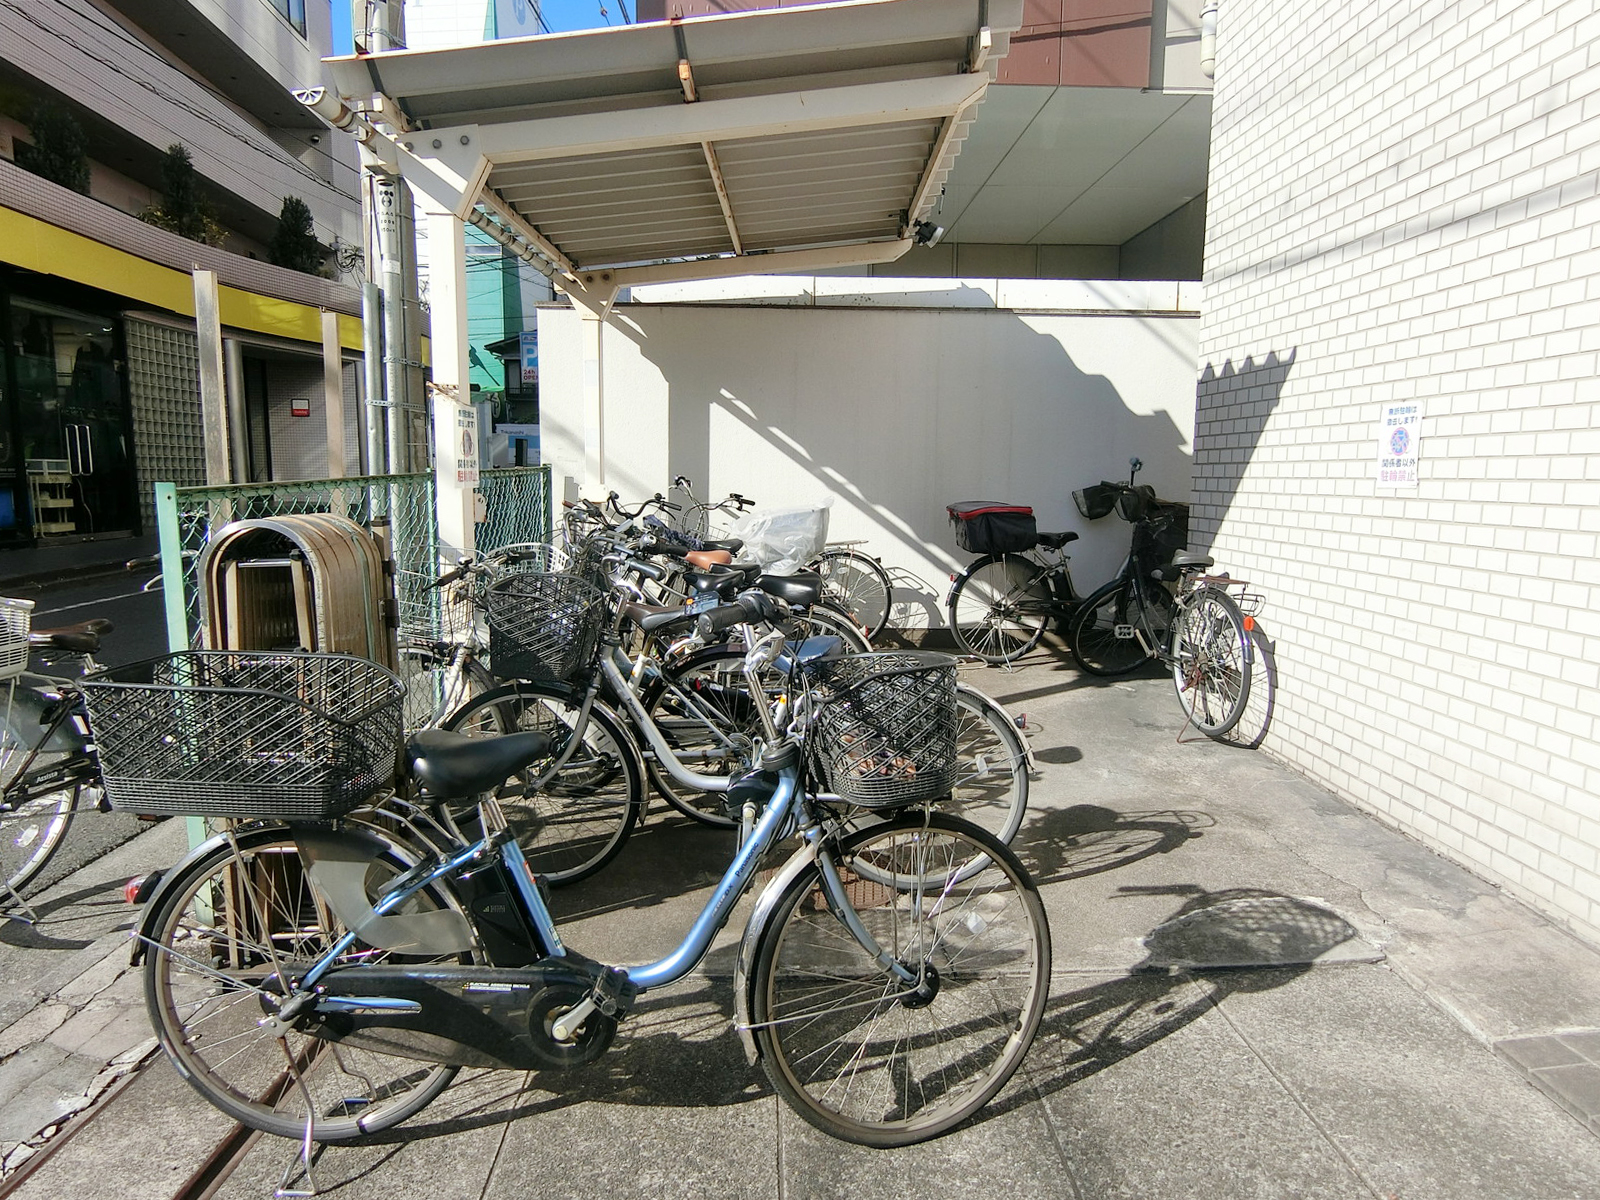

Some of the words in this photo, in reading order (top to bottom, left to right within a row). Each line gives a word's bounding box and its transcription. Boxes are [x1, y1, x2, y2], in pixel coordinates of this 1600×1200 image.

[523, 344, 538, 368] P
[1382, 458, 1416, 468] 関係者以外
[1381, 470, 1415, 482] 駐輪禁止
[627, 697, 645, 722] Panasonic
[36, 771, 58, 784] Assista
[734, 842, 759, 878] Panasonic
